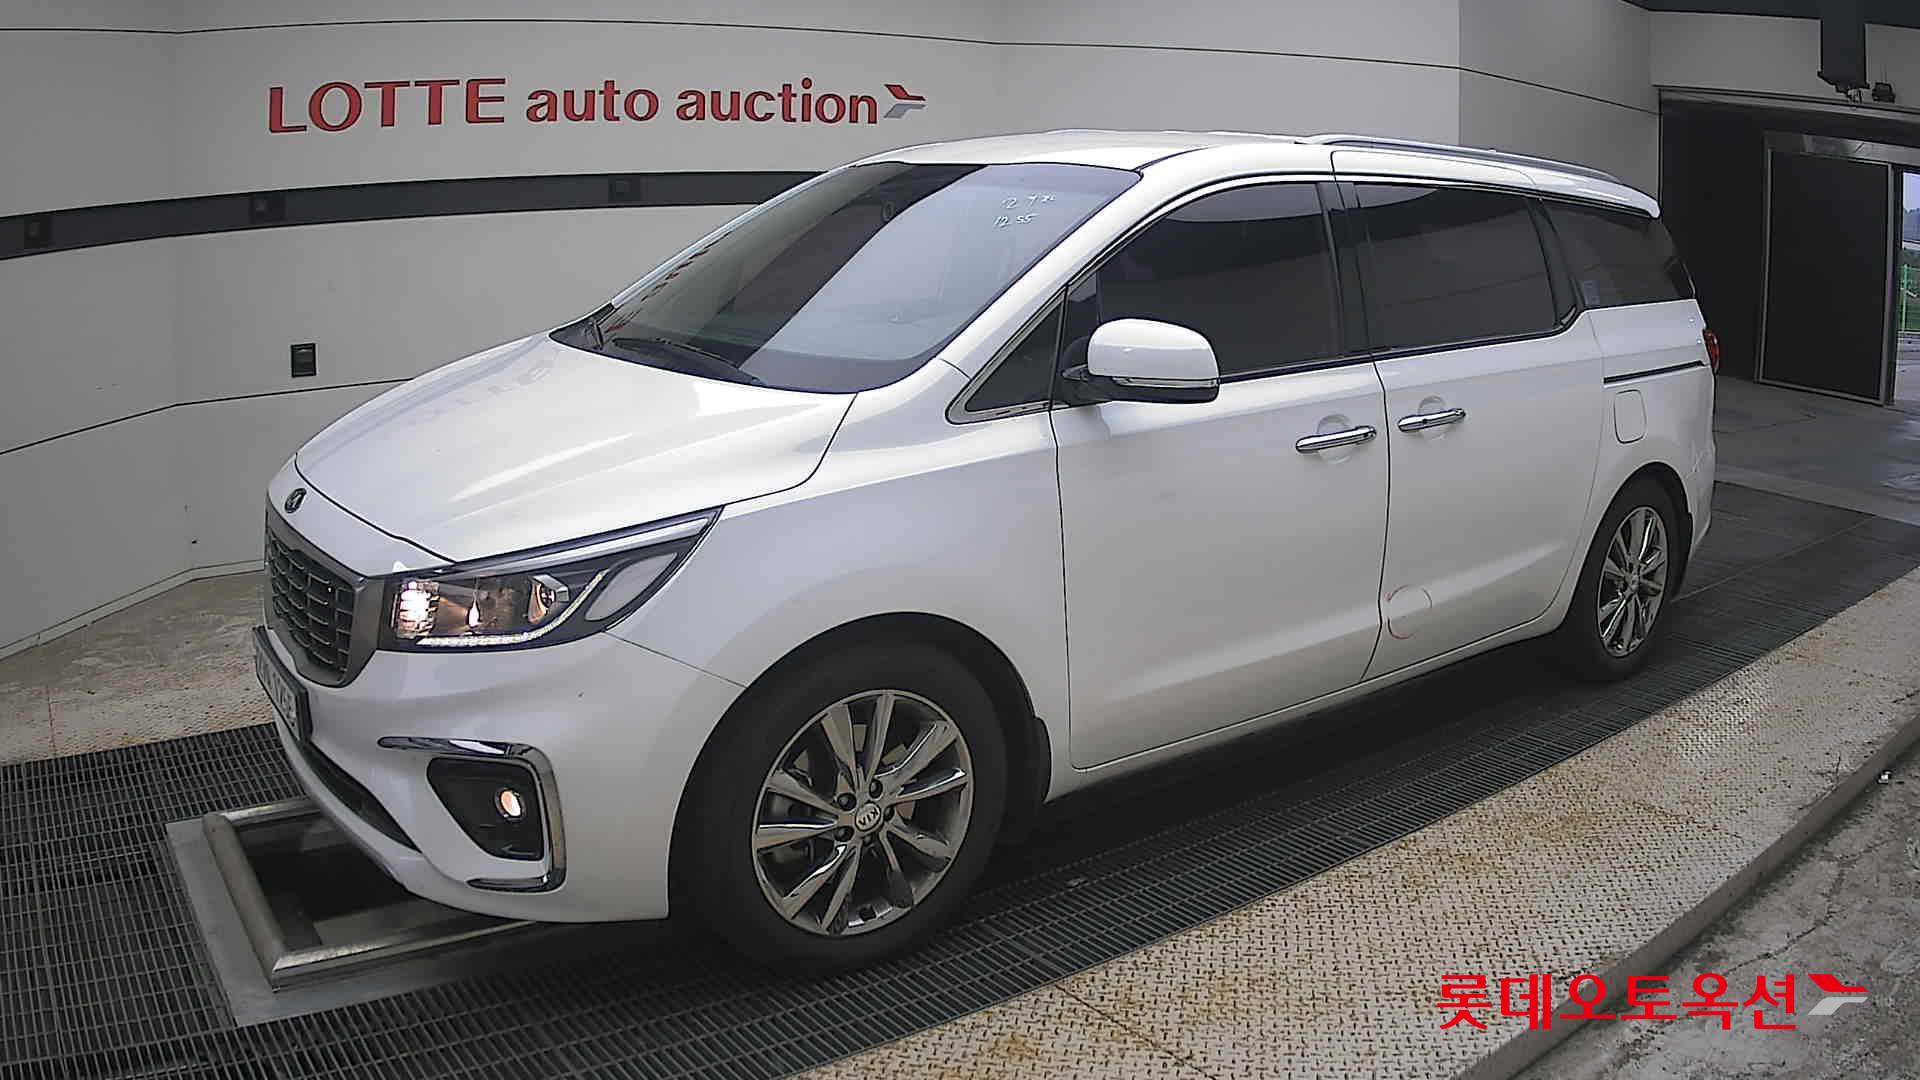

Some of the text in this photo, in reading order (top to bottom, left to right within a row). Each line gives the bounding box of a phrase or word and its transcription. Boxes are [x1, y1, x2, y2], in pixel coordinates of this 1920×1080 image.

[269, 77, 879, 133] LOTTE auto auction
